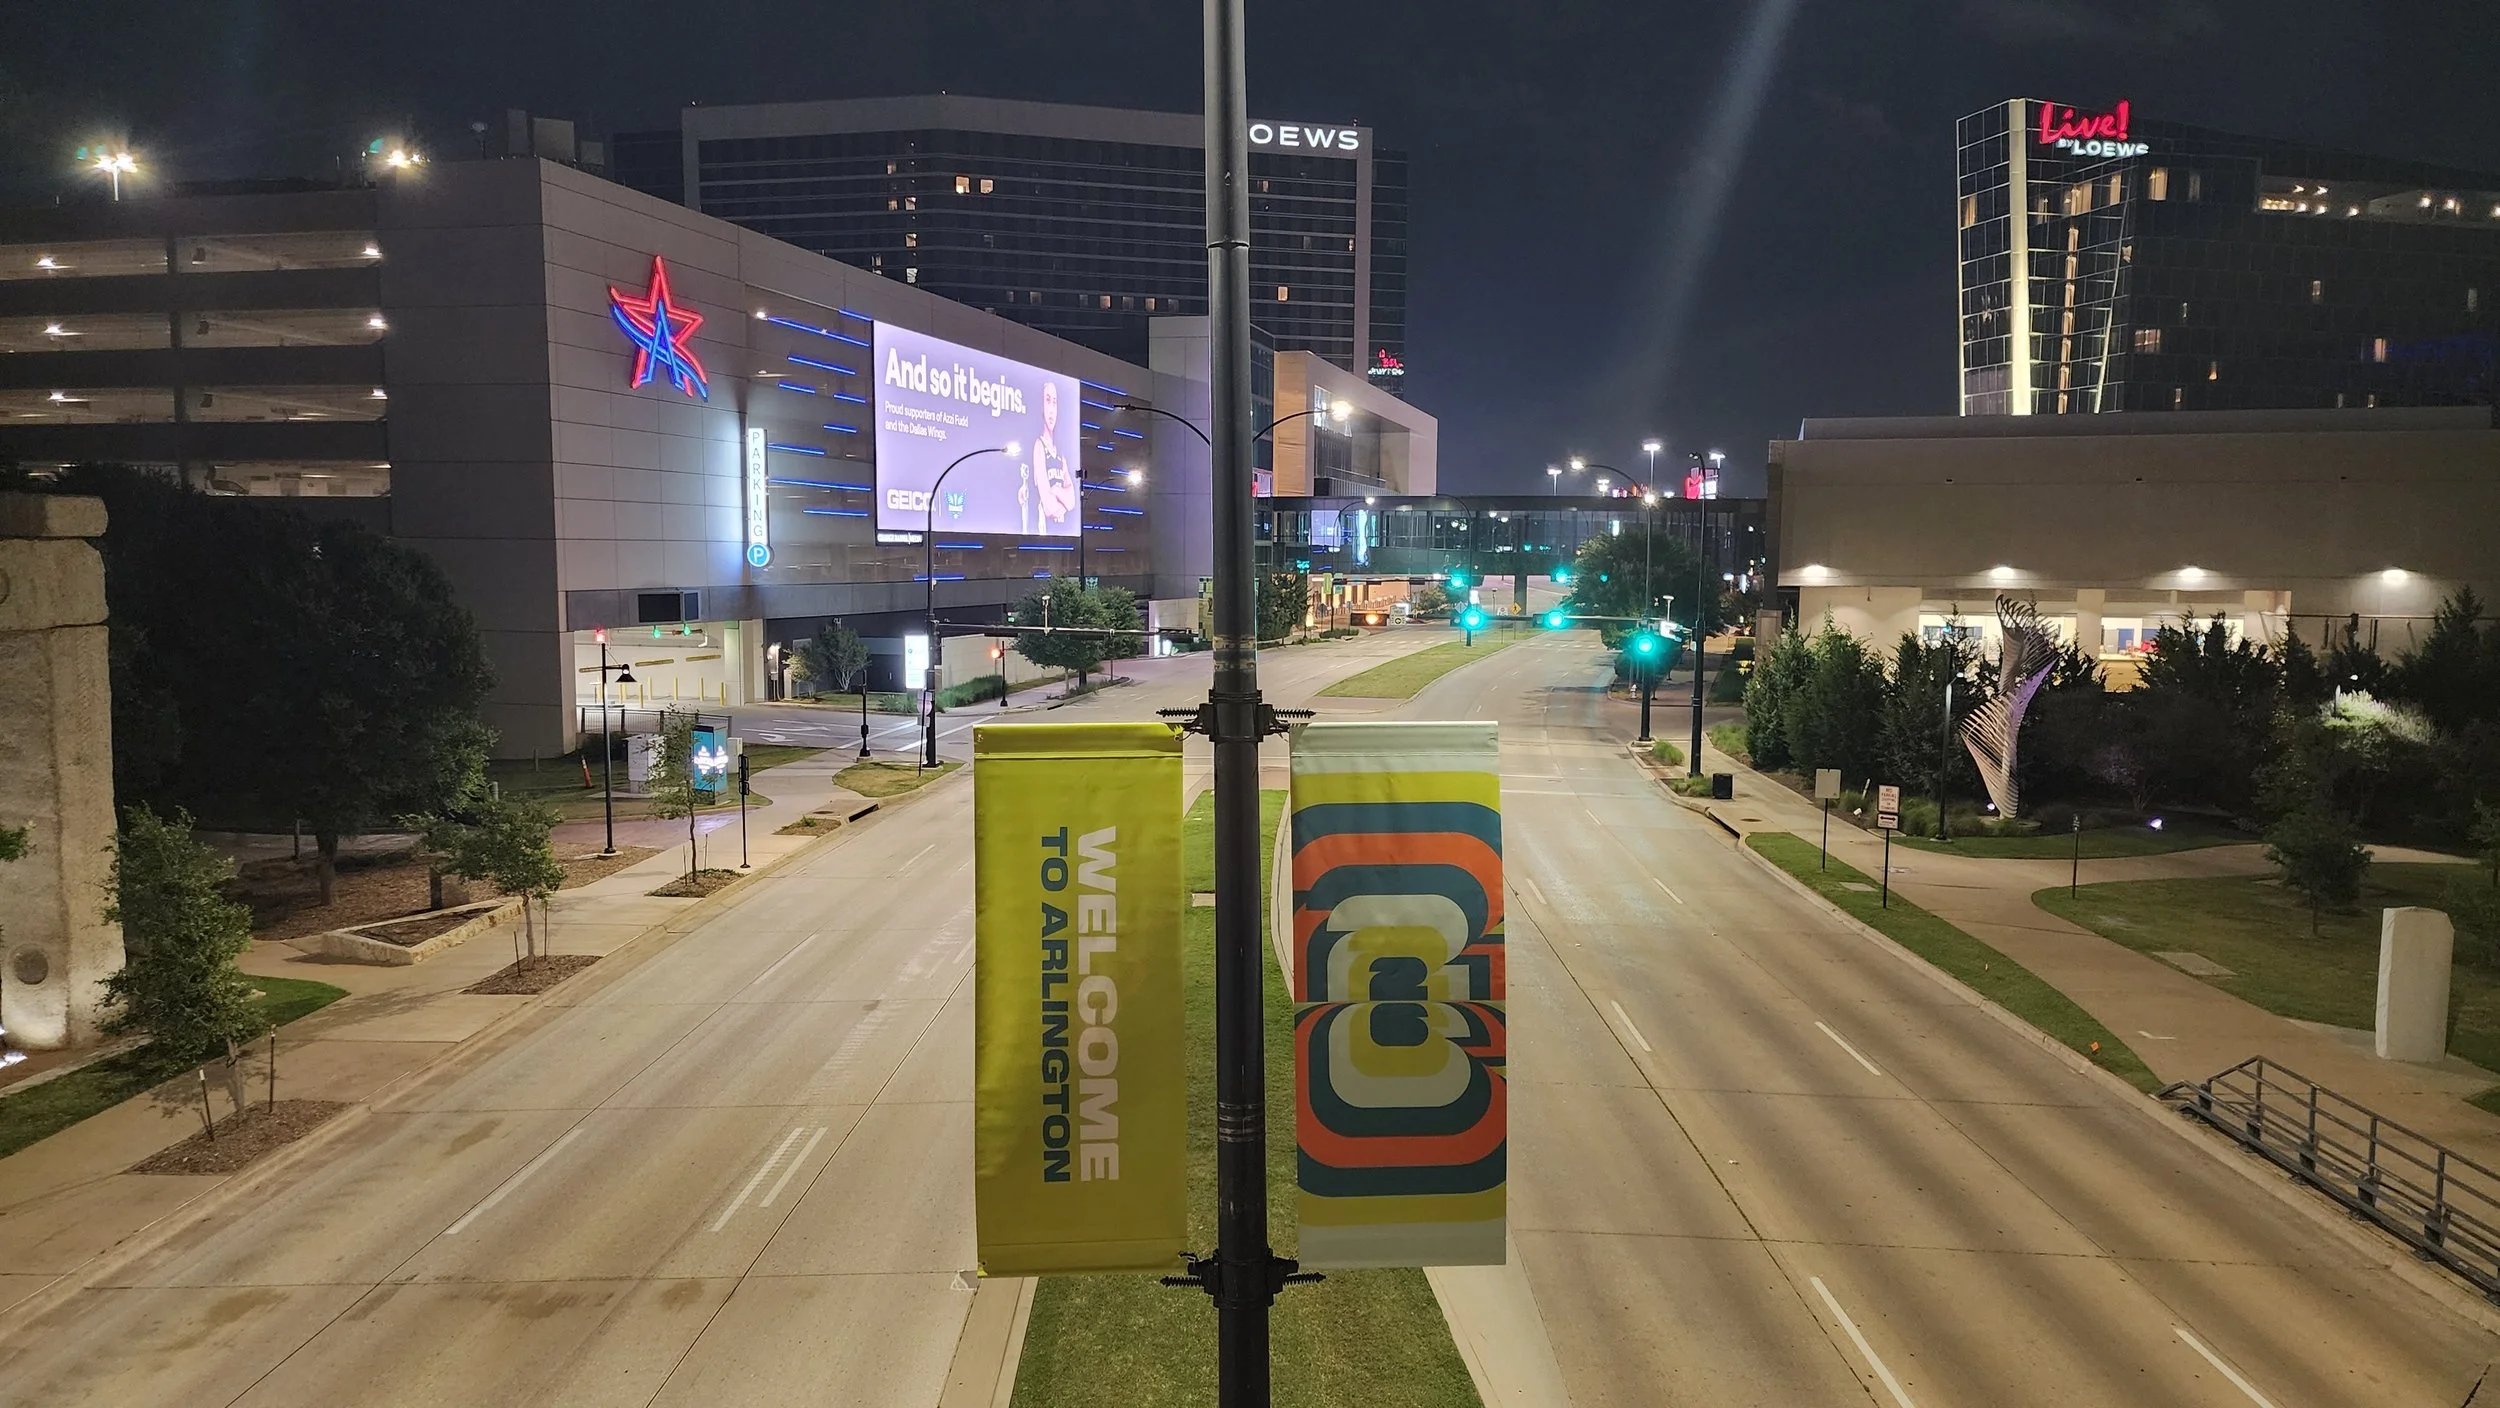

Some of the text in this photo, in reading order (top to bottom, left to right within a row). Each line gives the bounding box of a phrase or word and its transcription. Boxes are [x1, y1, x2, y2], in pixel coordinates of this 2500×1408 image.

[1249, 123, 1360, 150] OEWS
[2039, 99, 2129, 144] Live!
[2056, 138, 2074, 148] BY
[885, 347, 1026, 417] And so it begins.
[885, 400, 904, 416] Proud
[904, 407, 936, 421] supporters
[936, 411, 943, 423] of
[955, 414, 969, 428] Fudd
[885, 420, 897, 432] and
[898, 421, 909, 433] the
[909, 422, 927, 437] Dallas
[751, 431, 763, 538] PARKING
[1040, 826, 1071, 1183] TO ARLINGTON
[1077, 825, 1119, 1182] WELCOME
